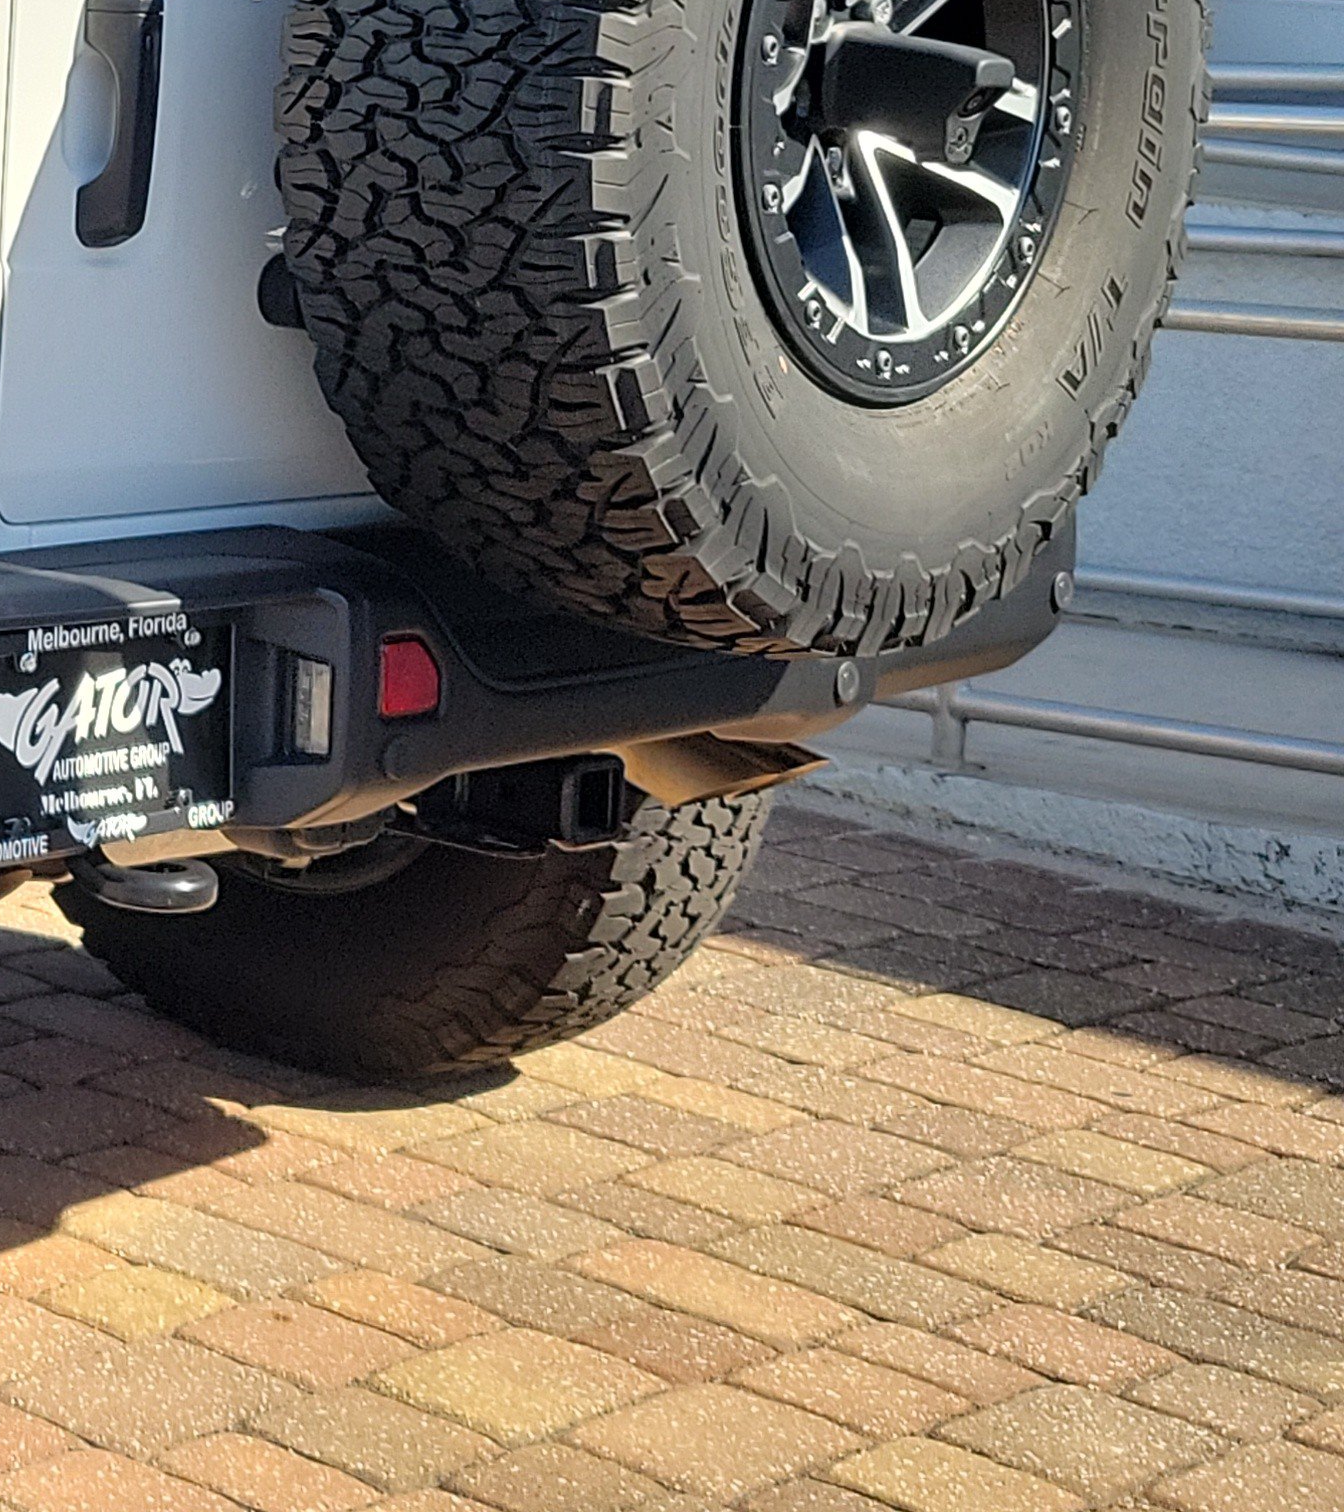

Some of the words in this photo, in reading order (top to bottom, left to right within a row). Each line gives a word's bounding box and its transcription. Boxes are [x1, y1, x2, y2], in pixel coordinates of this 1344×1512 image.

[27, 624, 124, 652] Melbourne,
[128, 612, 187, 638] Florida
[16, 662, 184, 786] GATOR
[52, 748, 129, 782] AUTOMOTIVE
[130, 741, 170, 771] GROUP
[83, 813, 136, 849] GATOR
[187, 800, 234, 829] GROUP
